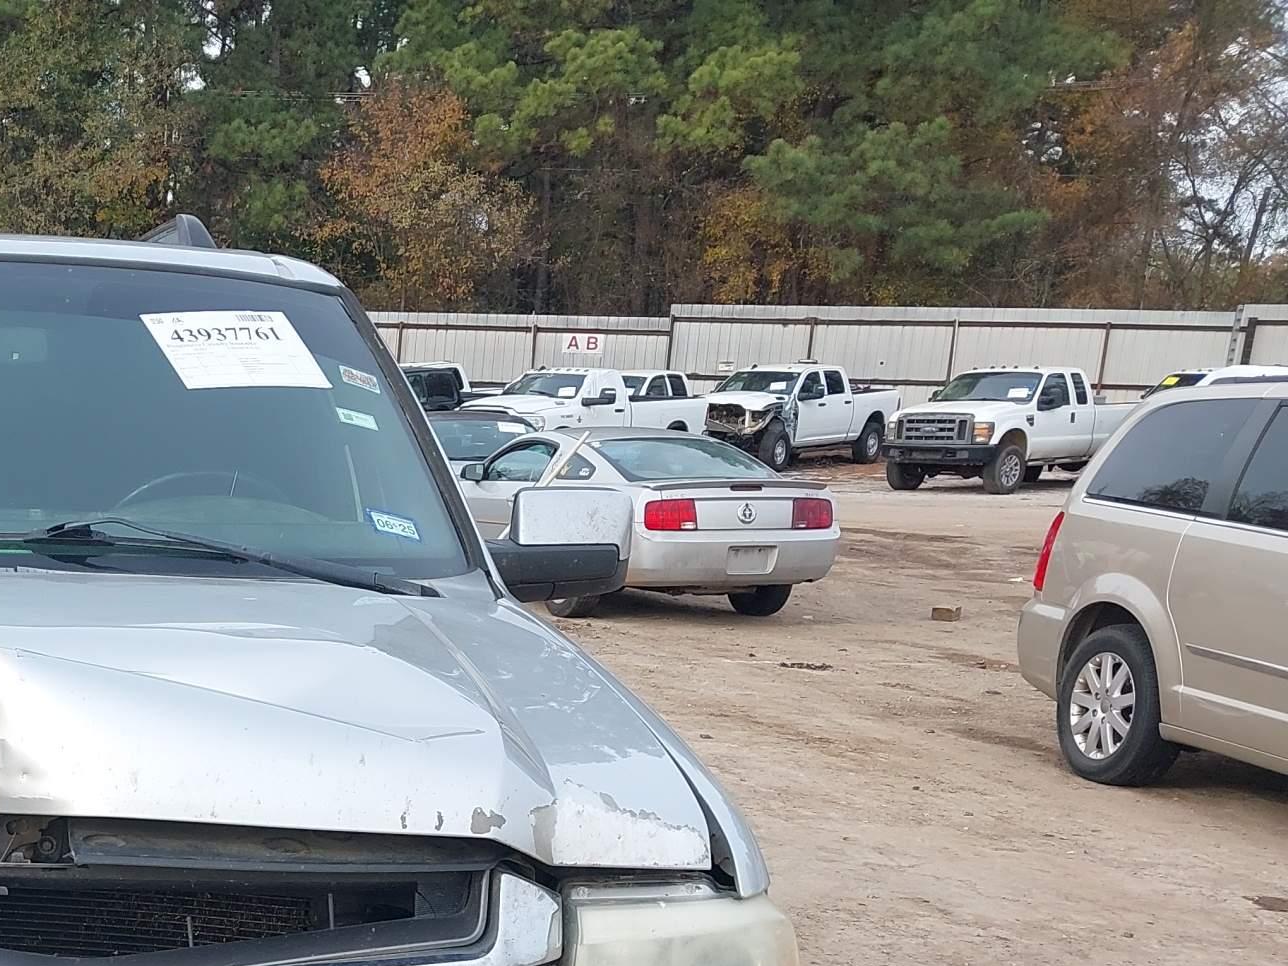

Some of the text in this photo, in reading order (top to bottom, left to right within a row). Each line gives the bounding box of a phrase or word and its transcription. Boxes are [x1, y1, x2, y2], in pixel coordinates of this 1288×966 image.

[170, 327, 283, 343] 43937761
[567, 335, 599, 351] A B
